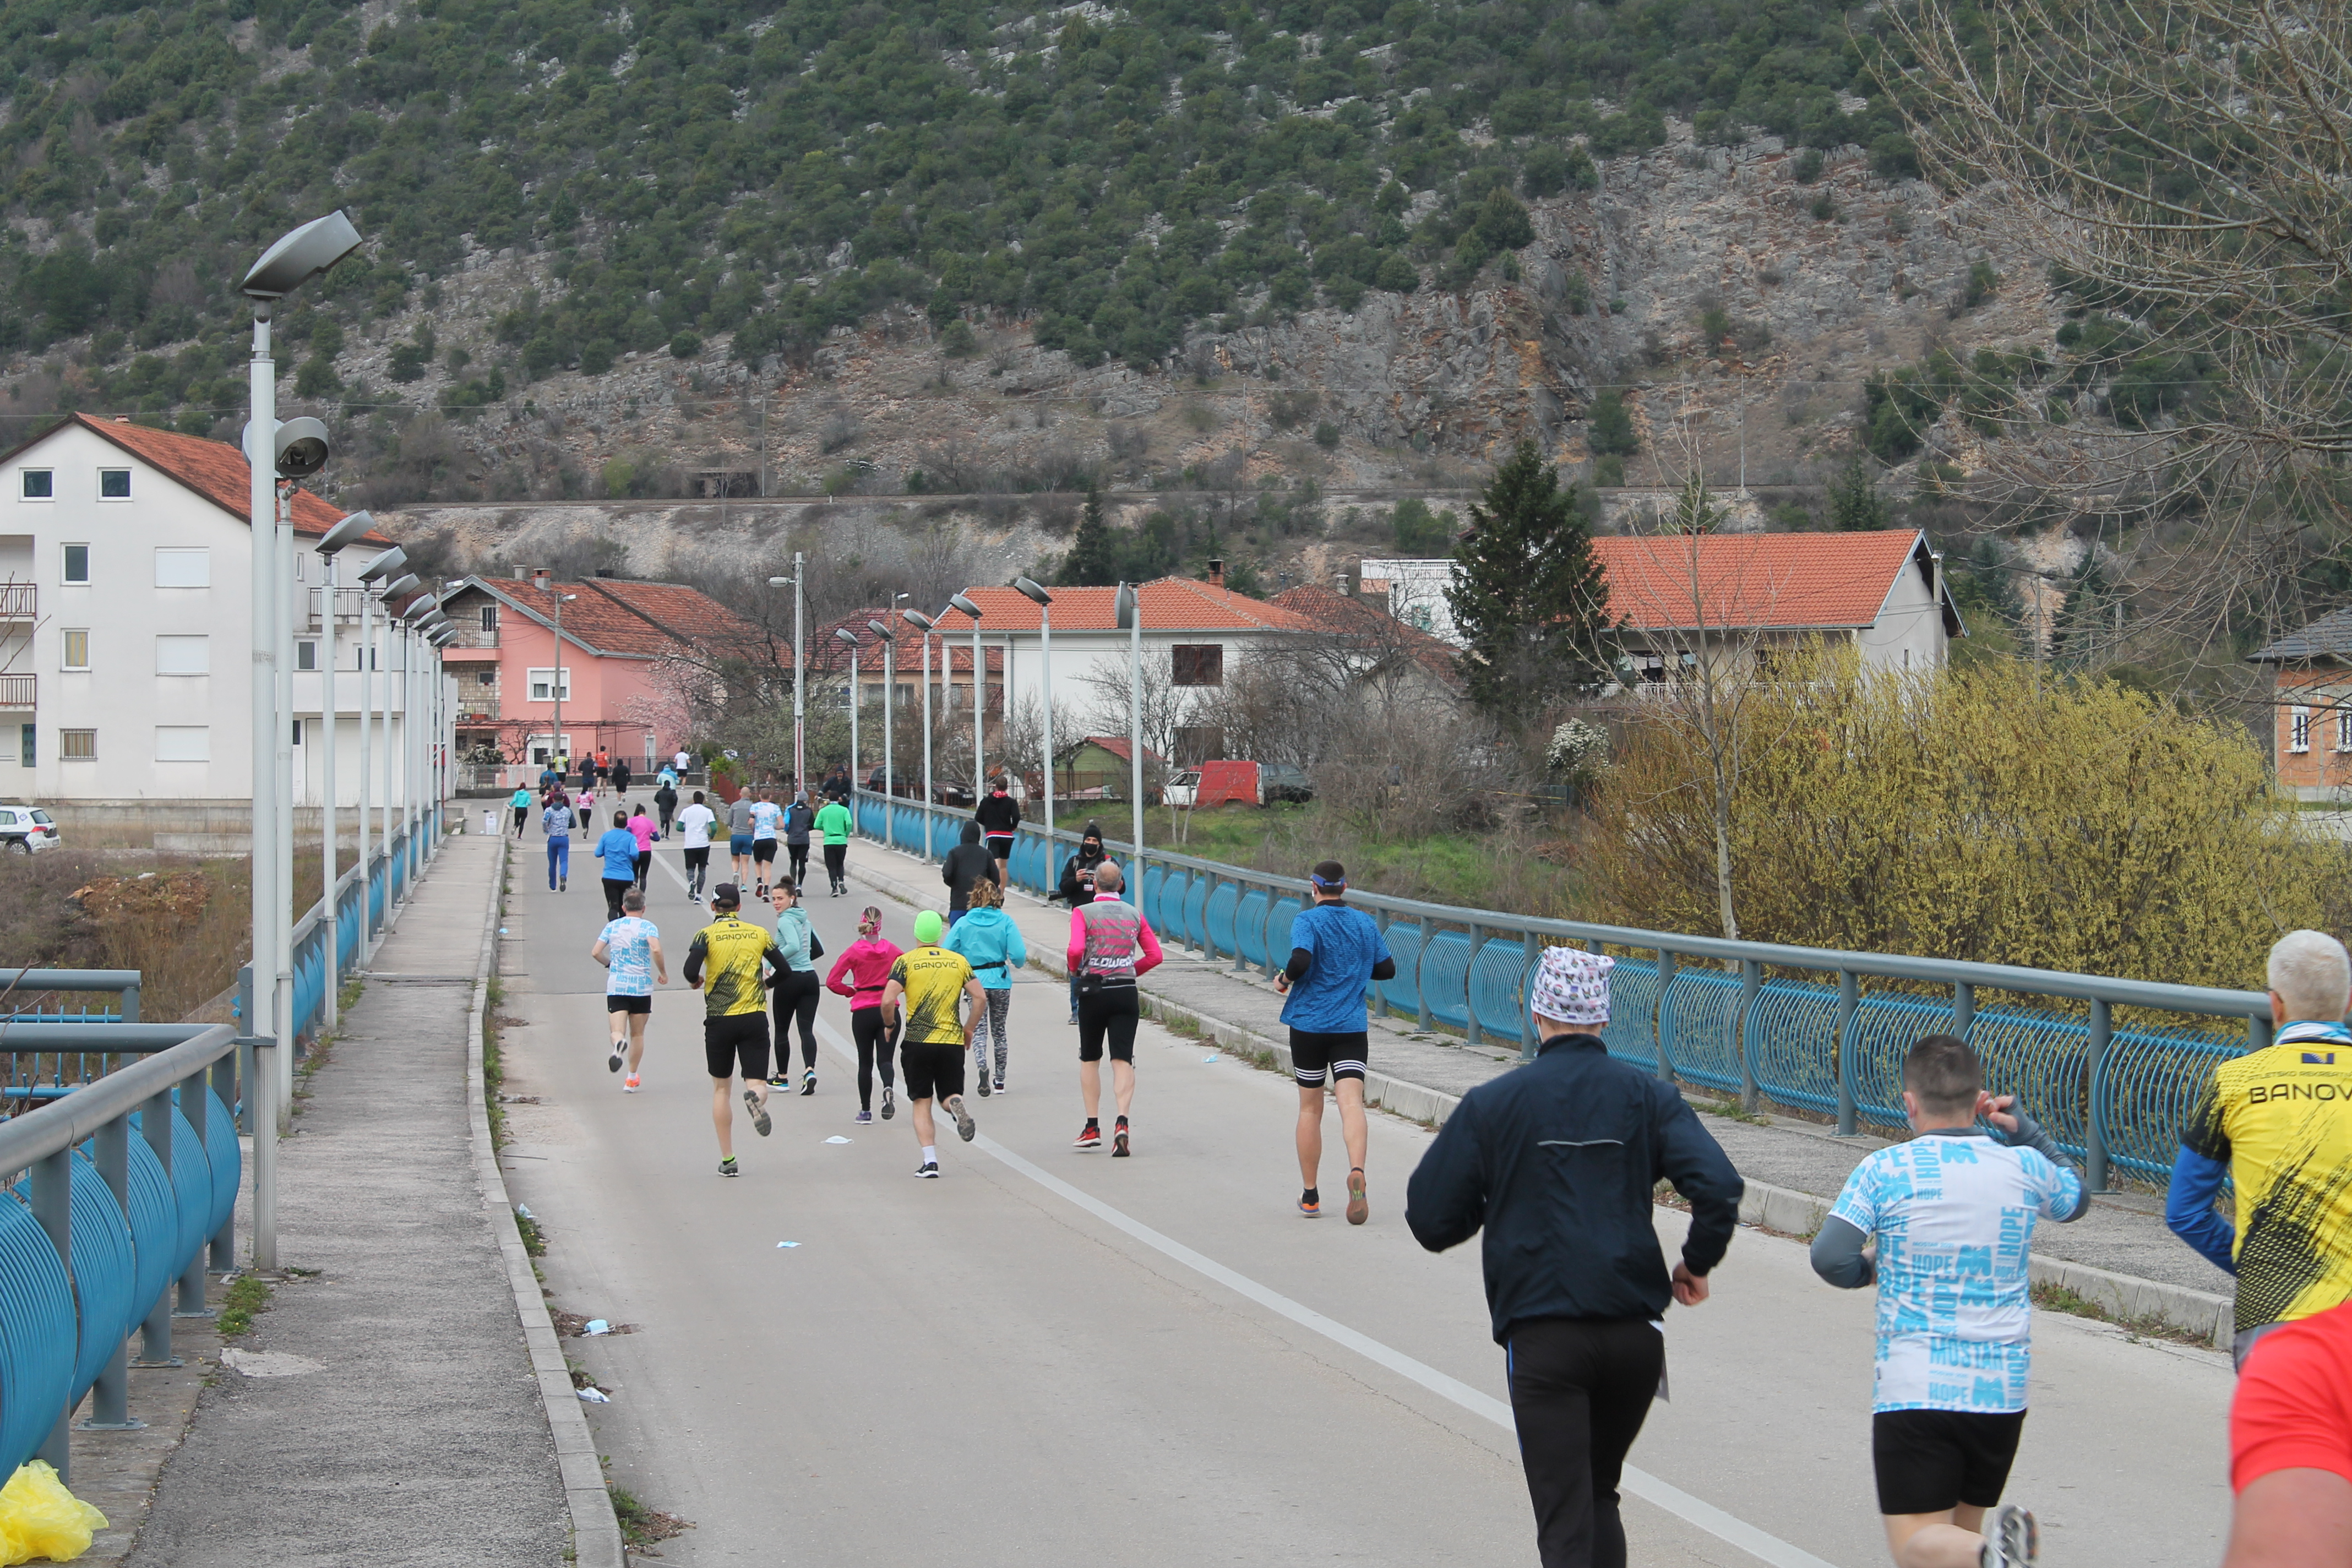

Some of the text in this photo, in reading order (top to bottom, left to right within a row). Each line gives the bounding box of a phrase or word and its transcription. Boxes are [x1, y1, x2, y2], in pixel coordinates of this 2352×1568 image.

[716, 932, 758, 941] BANOVIĆI
[914, 961, 958, 970] BANOVIĆI
[1910, 1140, 1941, 1178] HOPE
[1917, 1188, 1943, 1200] HOPE
[1997, 1206, 2024, 1256] HOPE
[1912, 1254, 1953, 1275] HOPE
[1931, 1275, 1960, 1321] HOPE
[1929, 1337, 2004, 1371] MOSTAR
[1929, 1382, 1969, 1404] HOPE
